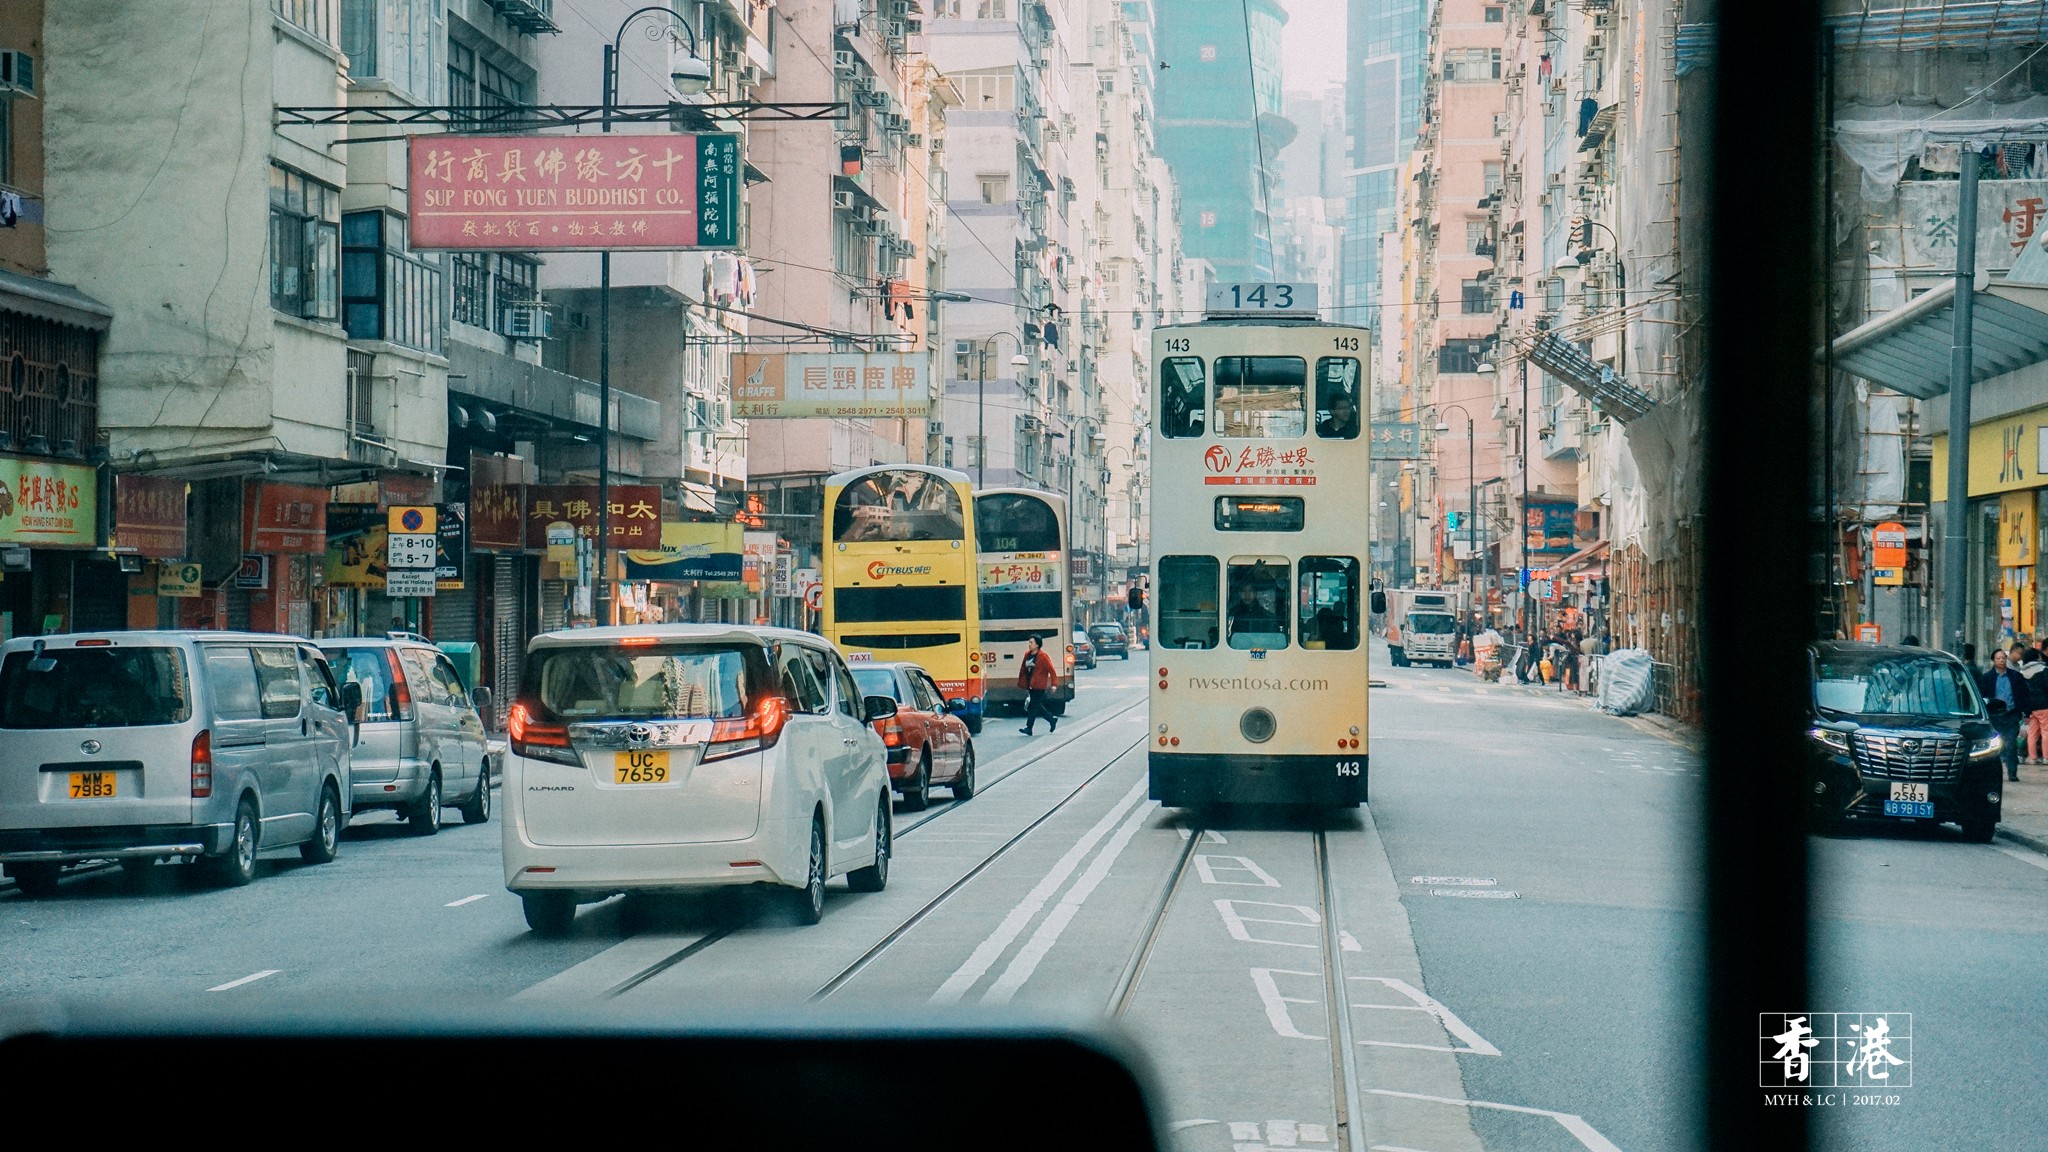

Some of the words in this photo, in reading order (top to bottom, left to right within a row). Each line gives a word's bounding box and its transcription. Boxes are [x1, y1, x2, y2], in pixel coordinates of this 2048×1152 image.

[704, 142, 719, 238] 南無阿彌陀佛
[424, 189, 455, 207] SUP
[463, 189, 508, 206] FONG
[516, 189, 558, 206] YUEN
[565, 189, 648, 206] BUDDHIST
[655, 189, 684, 206] CO.
[1926, 214, 1958, 247] 茶
[1231, 285, 1294, 309] 143
[1165, 339, 1190, 352] 143
[1333, 337, 1359, 351] 143
[803, 366, 916, 390] 長頸鹿牌
[738, 386, 776, 397] GIRAFFE
[737, 403, 779, 415] 大利行
[837, 407, 856, 415] 2548
[858, 407, 877, 415] 2971
[886, 407, 905, 415] 2548
[907, 407, 926, 415] 3011
[1235, 445, 1315, 473] 名勝世界
[406, 538, 434, 549] 8-10
[996, 538, 1017, 549] 104
[683, 569, 703, 577] 大利行
[876, 566, 914, 575] CITYBUS
[914, 565, 931, 574] 城巴
[850, 653, 871, 662] TAXI
[1189, 676, 1329, 691] rwsentosa.com
[630, 754, 653, 768] UC
[618, 767, 665, 783] 7659
[1336, 762, 1360, 776] 143
[82, 773, 102, 785] MM
[72, 784, 112, 797] 7983
[1901, 783, 1917, 793] FV
[1893, 792, 1925, 802] 2583
